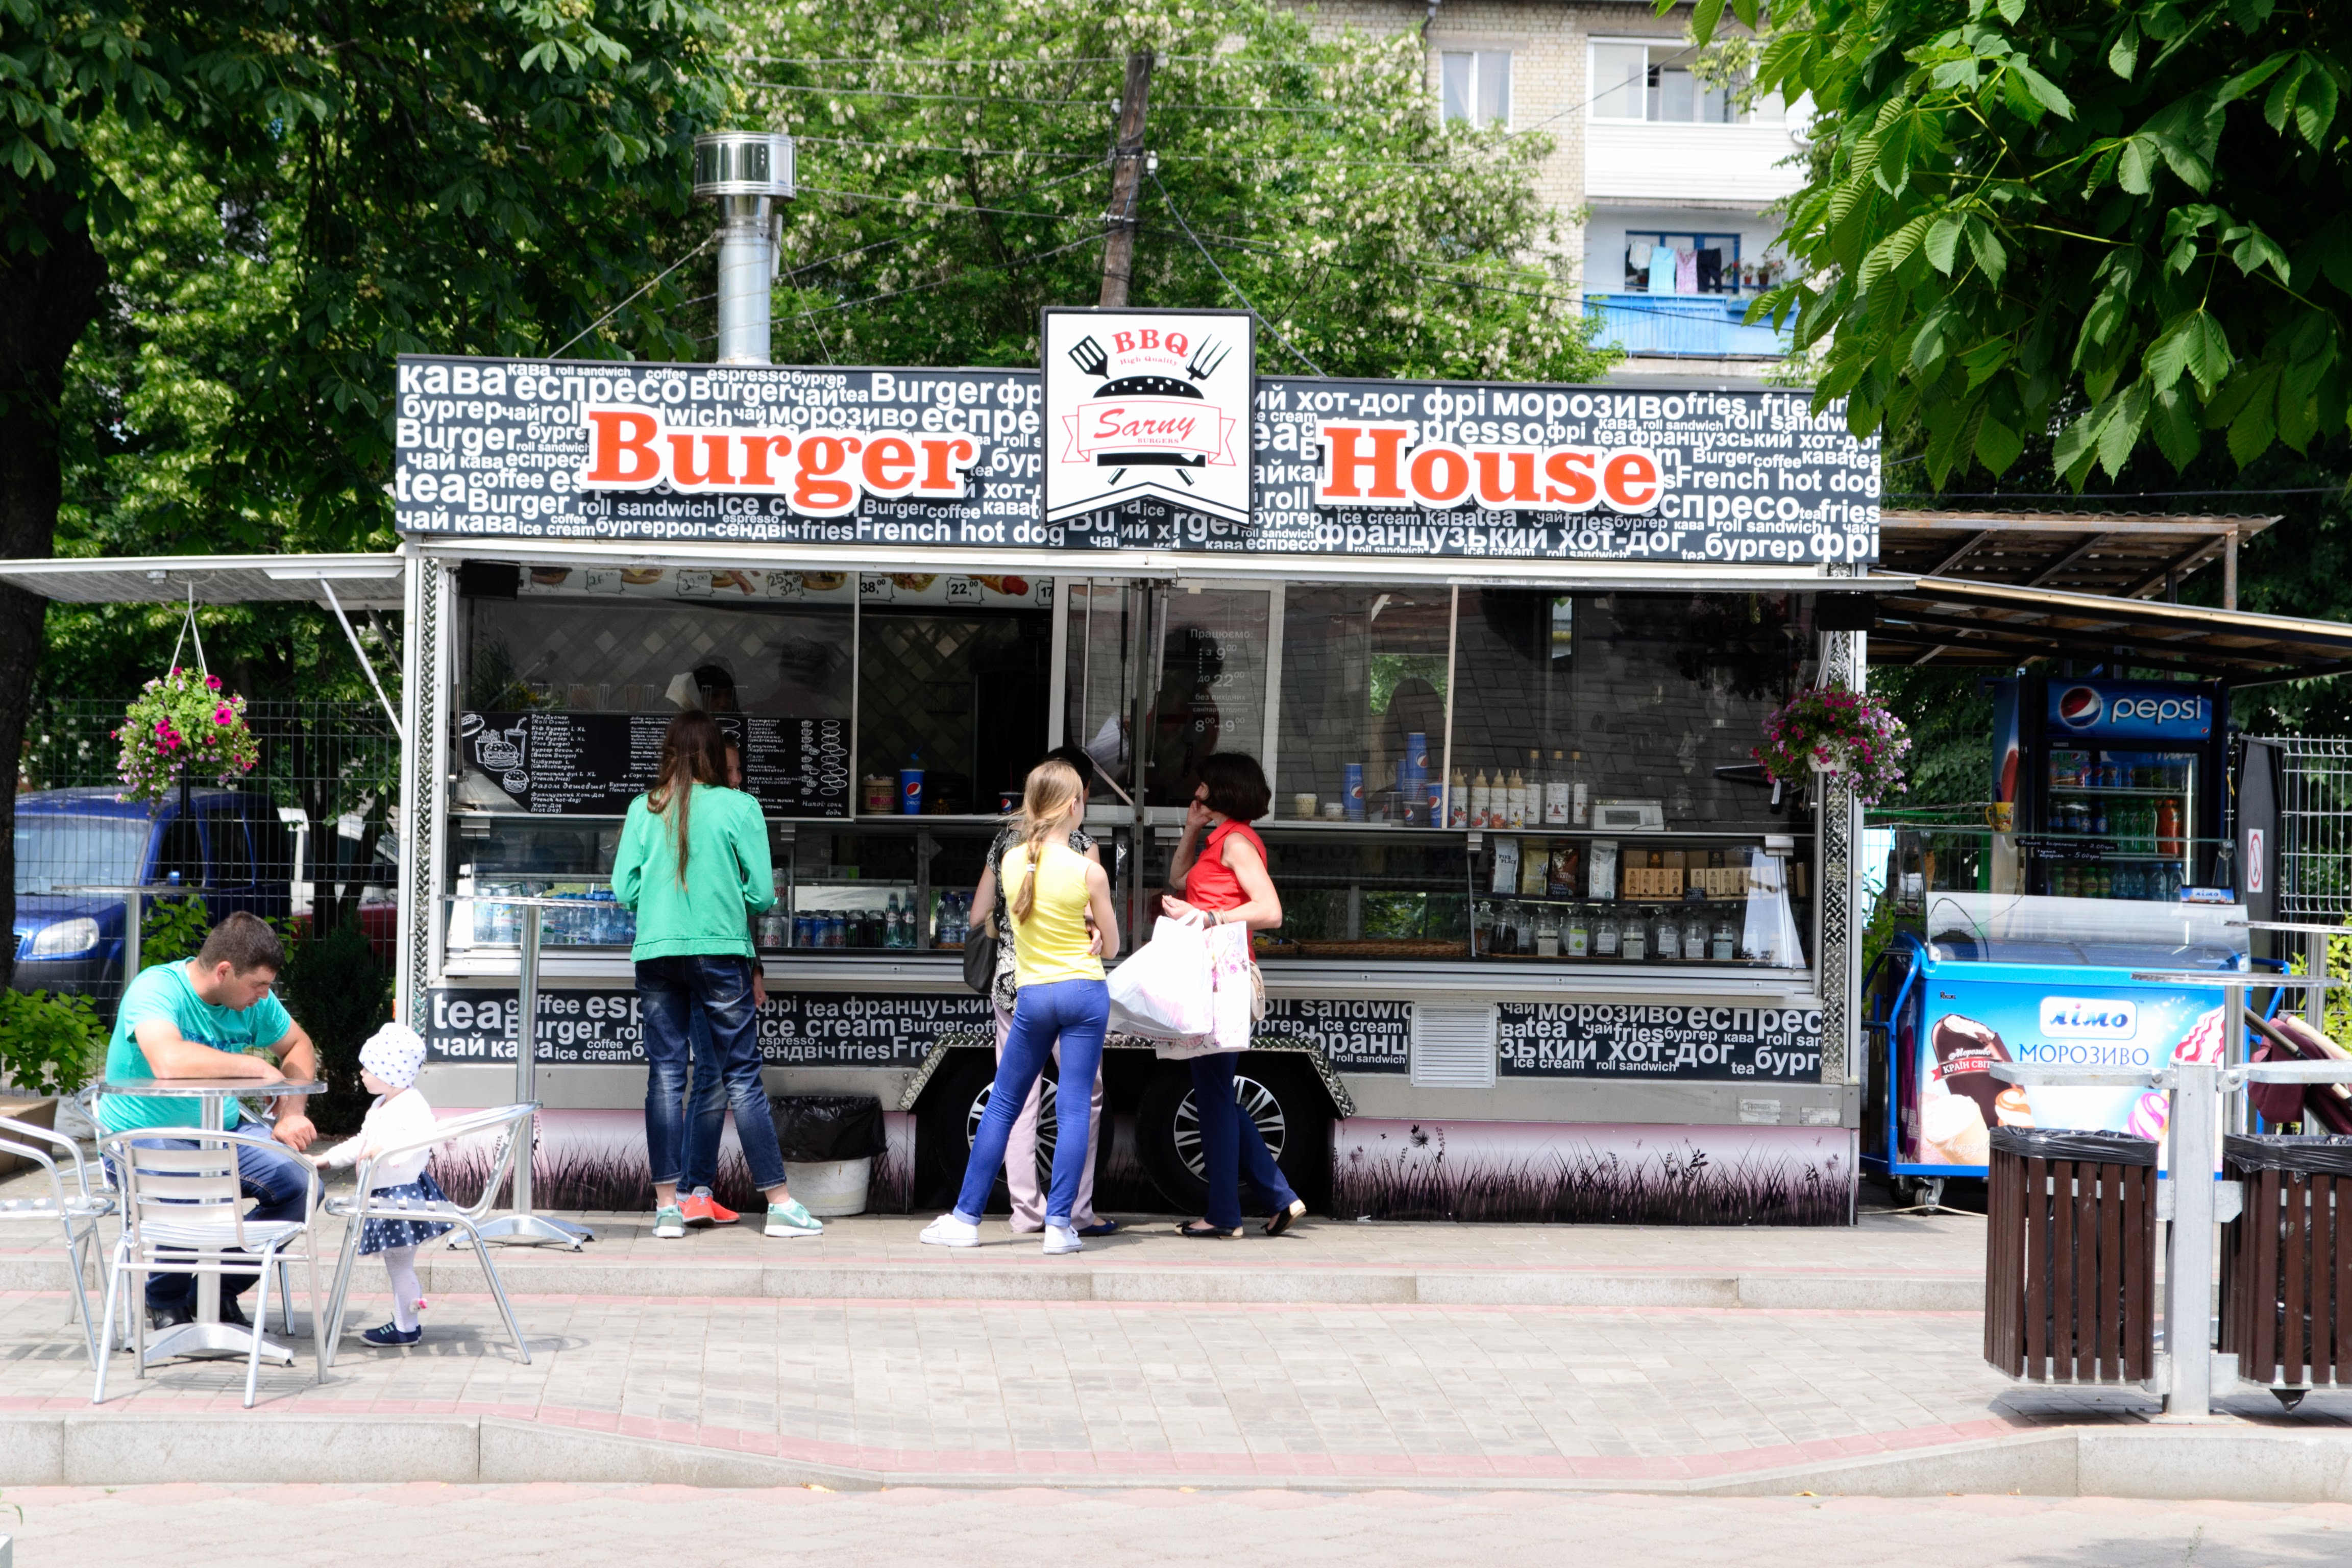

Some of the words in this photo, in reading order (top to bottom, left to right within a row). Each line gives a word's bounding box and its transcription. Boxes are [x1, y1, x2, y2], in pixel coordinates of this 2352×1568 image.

[1112, 329, 1189, 358] BBQ
[507, 363, 550, 376] кава
[1119, 356, 1141, 365] High
[1144, 355, 1178, 367] Quality
[399, 364, 507, 395] кава
[555, 365, 575, 376] roll
[577, 366, 631, 377] sandwich
[645, 368, 688, 380] coffee
[706, 369, 791, 384] espresso
[791, 371, 847, 388] бургер
[513, 375, 686, 405] еспресо
[690, 376, 792, 408] Burger
[789, 384, 838, 406] чай
[839, 386, 869, 403] tea
[871, 373, 995, 411] Burger
[403, 394, 502, 424] бургер
[502, 402, 539, 421] чай
[1296, 390, 1415, 417] хот-дог
[1423, 386, 1485, 422] фрі
[1492, 392, 1685, 425] морозиво
[1685, 391, 1747, 415] fries
[733, 405, 767, 421] чай
[769, 405, 918, 429] морозиво
[1269, 411, 1318, 423] cream
[1724, 409, 1763, 430] roll
[1093, 408, 1197, 441] Sarny
[1546, 421, 1586, 444] фрі
[1598, 418, 1637, 431] кава
[1643, 419, 1663, 430] roll
[1666, 420, 1724, 432] sandwich
[396, 418, 522, 456] Burger
[1002, 434, 1029, 448] roll
[1592, 427, 1627, 445] tea
[516, 441, 535, 452] roll
[407, 447, 456, 471] чай
[460, 455, 504, 470] кава
[587, 410, 973, 510] Burger
[1322, 426, 1658, 506] House
[1693, 448, 1755, 468] Burger
[1752, 454, 1802, 469] coffee
[1802, 450, 1849, 465] кава
[1848, 450, 1881, 470] tea
[468, 467, 545, 489] coffee
[970, 465, 994, 477] tea
[395, 463, 466, 504] tea
[1676, 465, 1769, 491] French
[1778, 468, 1822, 492] hot
[1829, 470, 1881, 498] dog
[468, 488, 571, 520] Burger
[718, 493, 760, 516] ice
[1264, 486, 1309, 510] roll
[396, 505, 449, 530] чай
[578, 498, 611, 516] roll
[617, 499, 715, 518] sandwich
[864, 499, 927, 519] Burger
[927, 503, 981, 520] coffee
[983, 501, 1030, 516] кава
[1475, 508, 1517, 527] tea
[1800, 507, 1821, 520] tea
[1819, 498, 1881, 524] fries
[455, 514, 518, 533] кава
[550, 513, 587, 524] coffee
[595, 516, 666, 538] бургер
[722, 514, 779, 526] espresso
[1337, 510, 1362, 524] ice
[1367, 512, 1420, 526] cream
[1426, 510, 1476, 527] кава
[1563, 511, 1614, 531] fries
[1614, 515, 1668, 531] бургер
[1674, 520, 1705, 531] кава
[1716, 519, 1743, 532] roll
[1747, 519, 1822, 534] sandwich
[1843, 521, 1870, 534] чай
[519, 521, 543, 535] ice
[546, 524, 595, 536] cream
[666, 520, 799, 541] рол-сендвіч
[801, 520, 854, 541] fries
[855, 517, 951, 542] French
[960, 519, 1005, 543] hot
[1013, 520, 1065, 547] dog
[1241, 528, 1259, 538] roll
[1261, 528, 1314, 540] sandwich
[1245, 538, 1320, 552] еспресо
[1558, 529, 1686, 556] хот-дог
[1705, 532, 1805, 561] бургер
[1810, 525, 1879, 563] фрі
[2111, 695, 2202, 724] pepsi
[433, 992, 502, 1030] tea
[505, 994, 580, 1015] cffee
[805, 1000, 839, 1018] tea
[1538, 1003, 1683, 1027] морозиво
[2049, 1002, 2128, 1028] лімо
[805, 1018, 895, 1038] cream
[900, 1018, 964, 1036] Burger
[1319, 1017, 1344, 1033] ice
[1349, 1020, 1402, 1034] cream
[1526, 1016, 1567, 1038] tea
[1585, 1021, 1612, 1035] чай
[1613, 1022, 1664, 1043] fries
[1664, 1026, 1718, 1044] бургер
[433, 1032, 485, 1057] чай
[586, 1038, 623, 1049] coffee
[758, 1036, 815, 1047] espresso
[1724, 1033, 1754, 1043] кава
[1766, 1032, 1792, 1046] roll
[555, 1046, 578, 1060] ice
[582, 1048, 631, 1061] cream
[838, 1041, 891, 1060] fries
[1336, 1054, 1354, 1063] roll
[1356, 1054, 1405, 1065] sandwich
[1607, 1040, 1735, 1068] хот-дог
[2019, 1043, 2149, 1066] МОРОЗИВО
[1513, 1055, 1535, 1068] ice
[1539, 1059, 1585, 1069] cream
[1596, 1060, 1615, 1071] roll
[1619, 1061, 1676, 1072] sandwich
[1731, 1061, 1755, 1075] tea
[1942, 1059, 1970, 1074] КРАЇН
